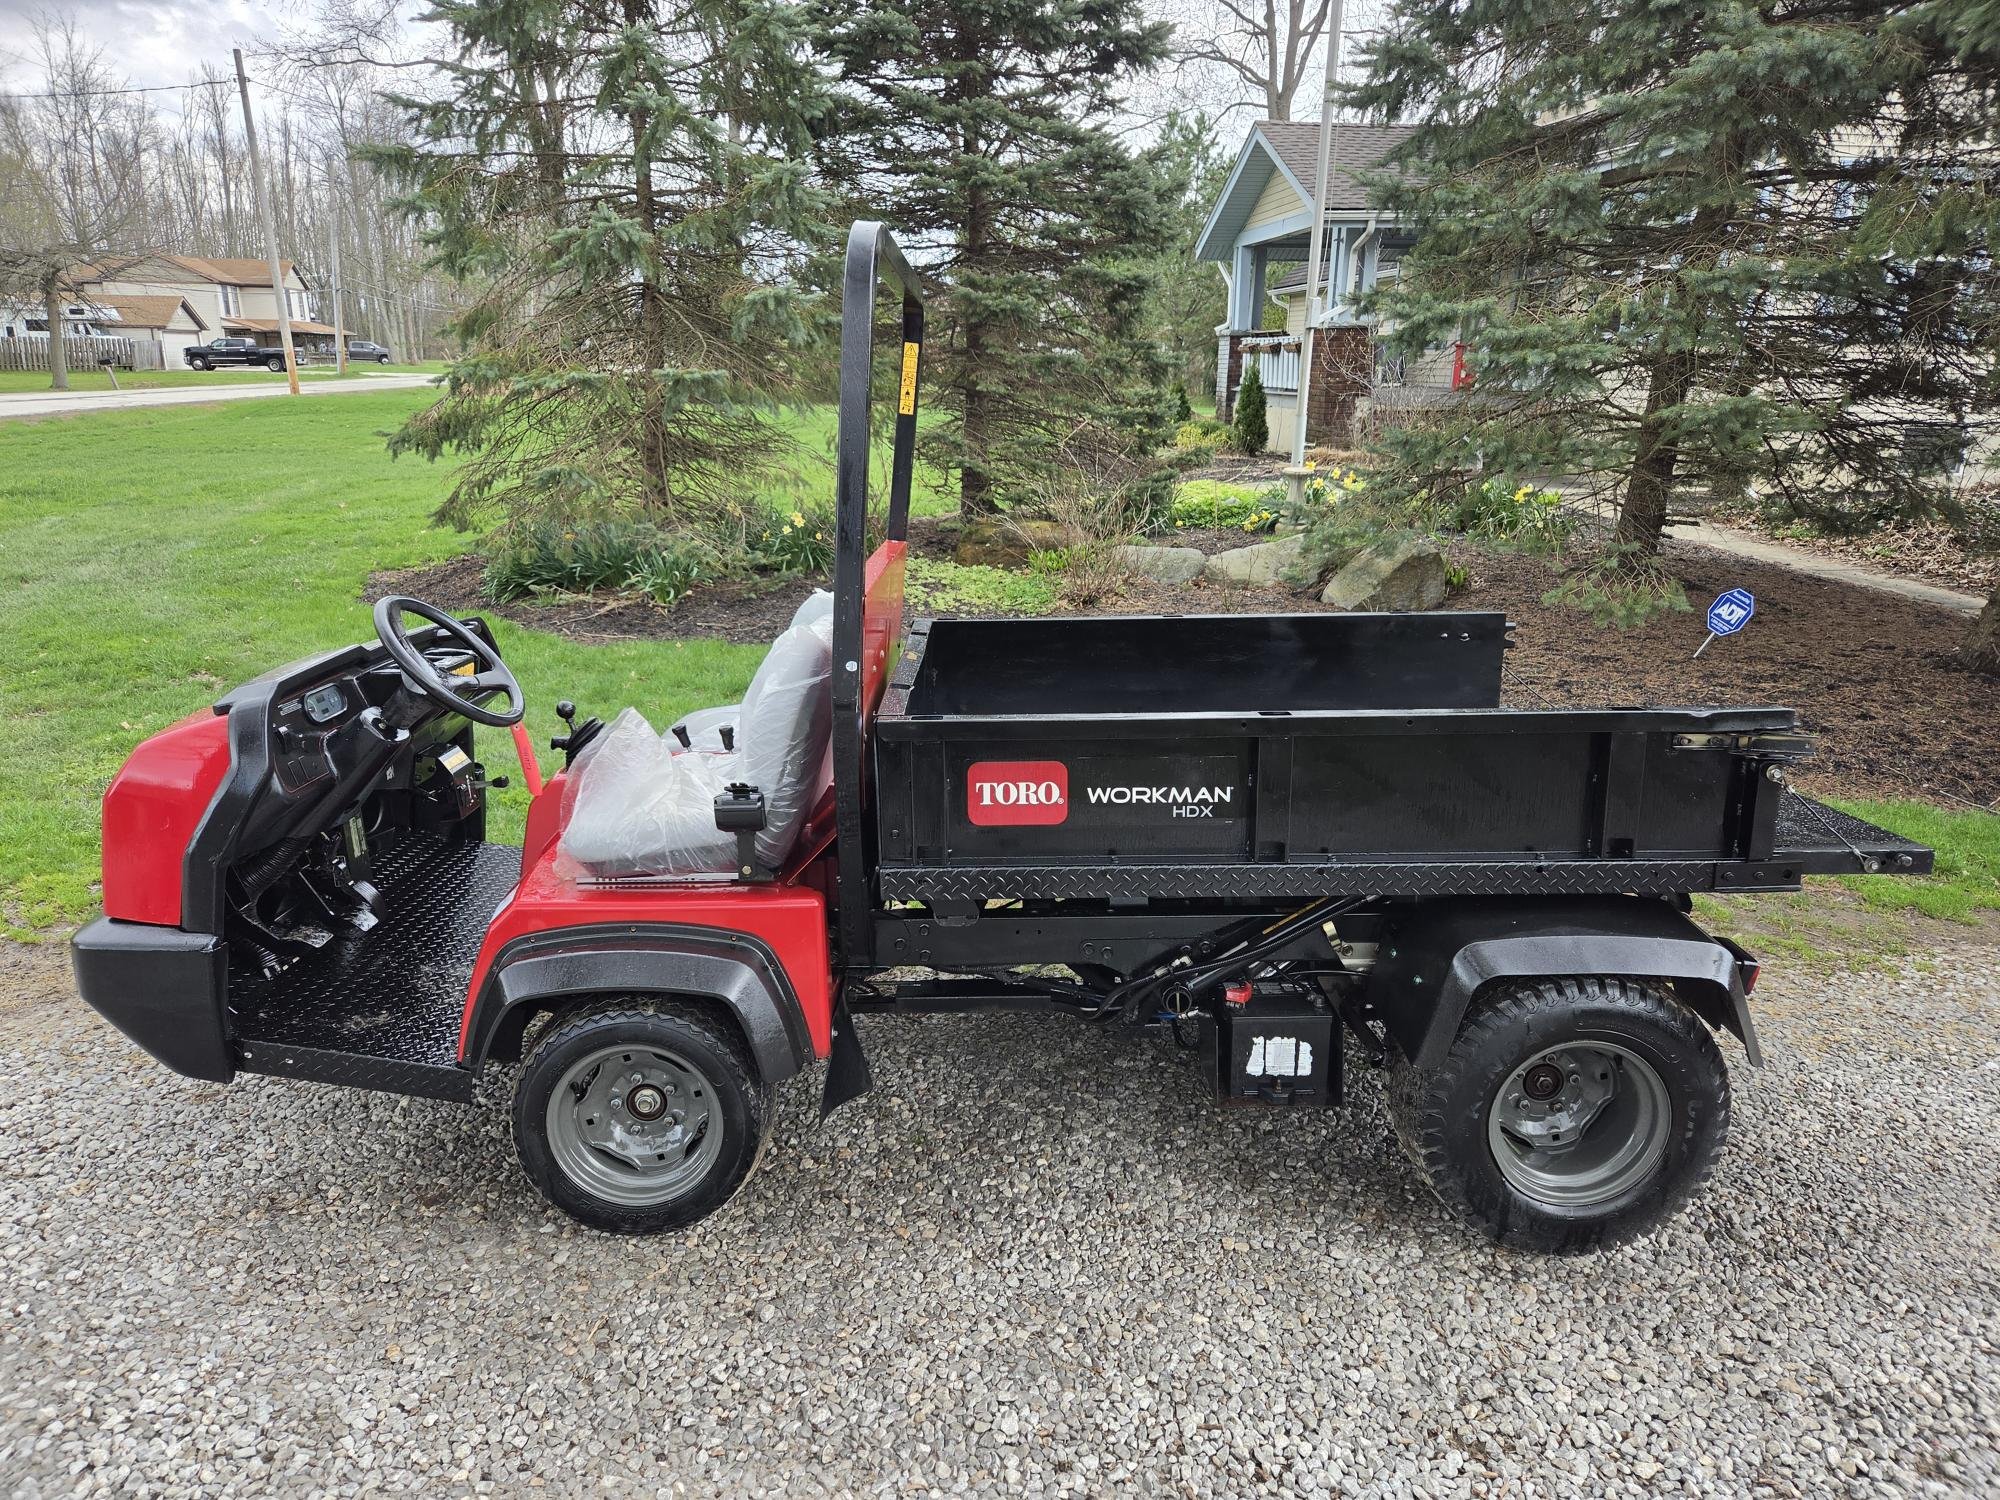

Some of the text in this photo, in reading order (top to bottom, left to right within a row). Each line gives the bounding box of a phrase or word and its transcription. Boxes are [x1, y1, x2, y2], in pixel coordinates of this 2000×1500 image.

[1713, 602, 1747, 625] ADT
[976, 782, 1060, 806] TORO
[1087, 786, 1232, 804] WORKMAN
[1172, 805, 1213, 818] HDX
